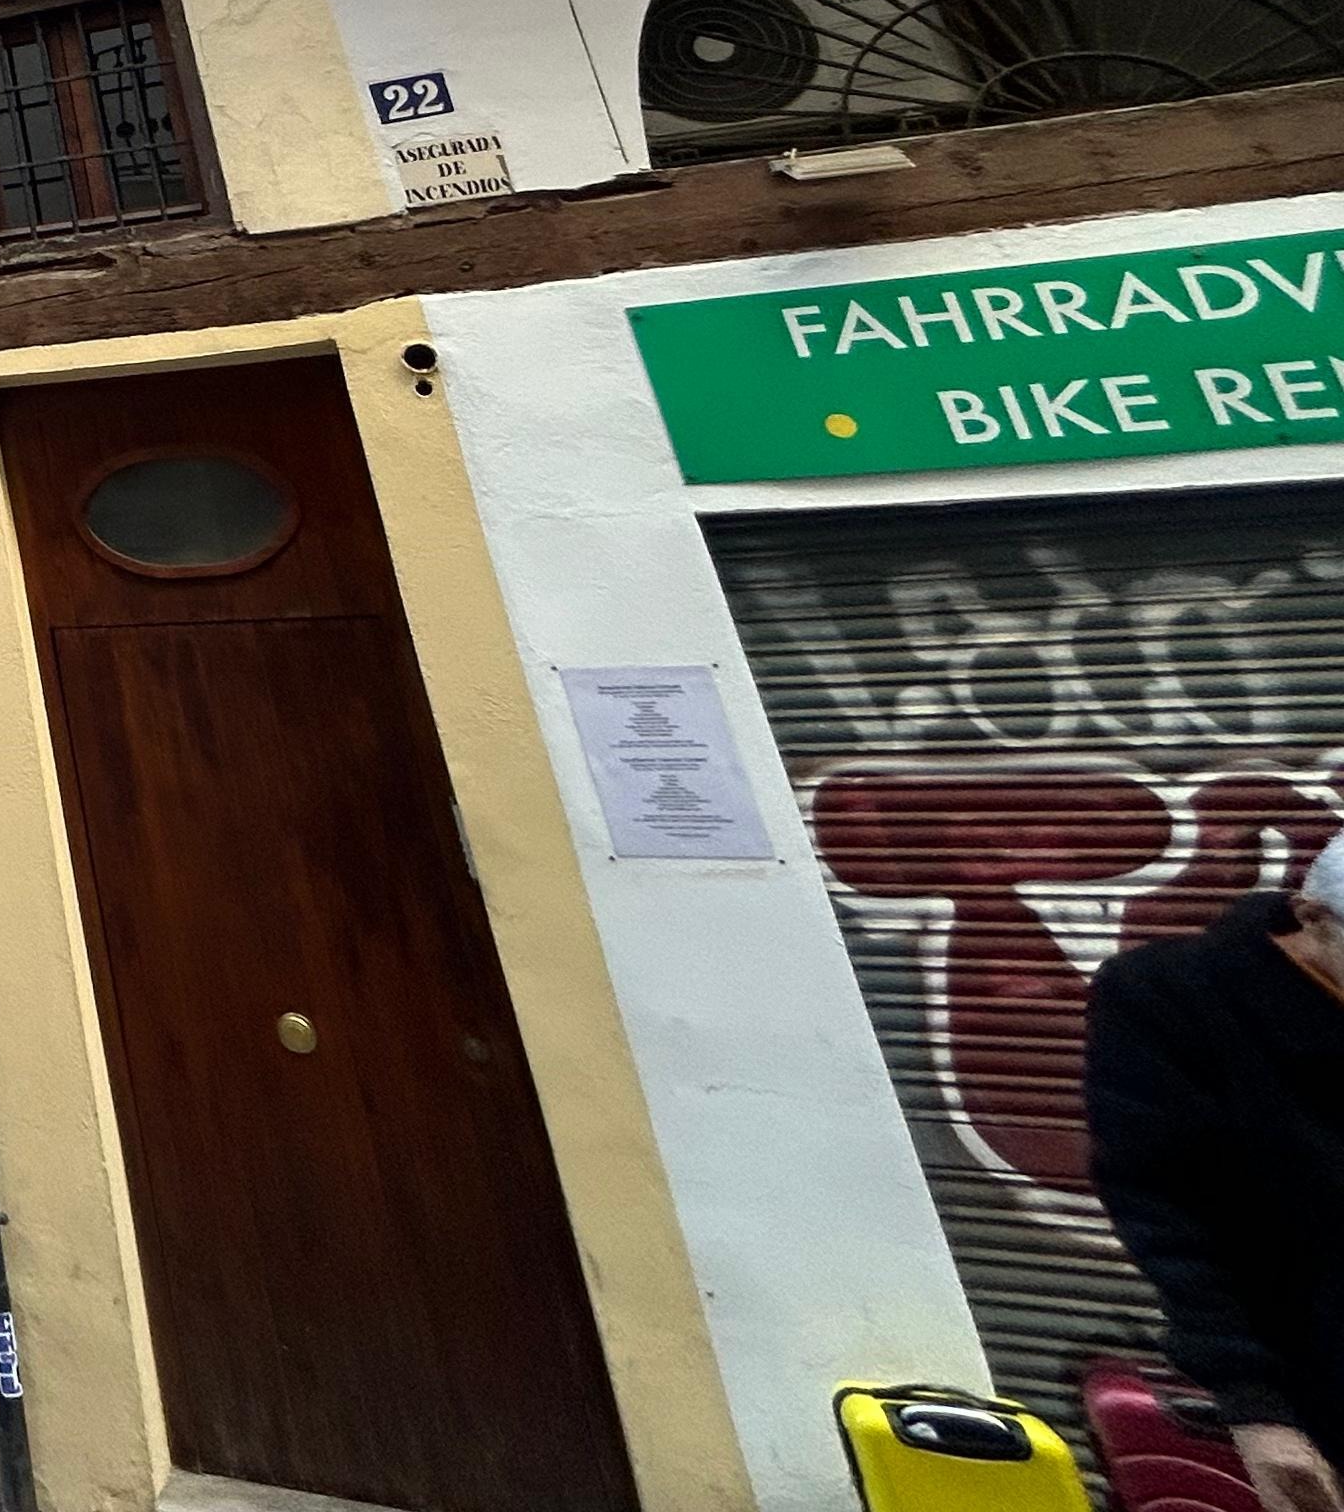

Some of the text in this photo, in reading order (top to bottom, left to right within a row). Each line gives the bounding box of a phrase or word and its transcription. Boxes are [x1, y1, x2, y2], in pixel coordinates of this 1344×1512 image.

[383, 79, 445, 120] 22
[396, 136, 502, 164] ASEGURADA
[438, 161, 467, 178] DE
[405, 175, 512, 204] INCENDIOS
[782, 250, 1344, 359] FAHRRADV
[937, 374, 1170, 445] BIKE
